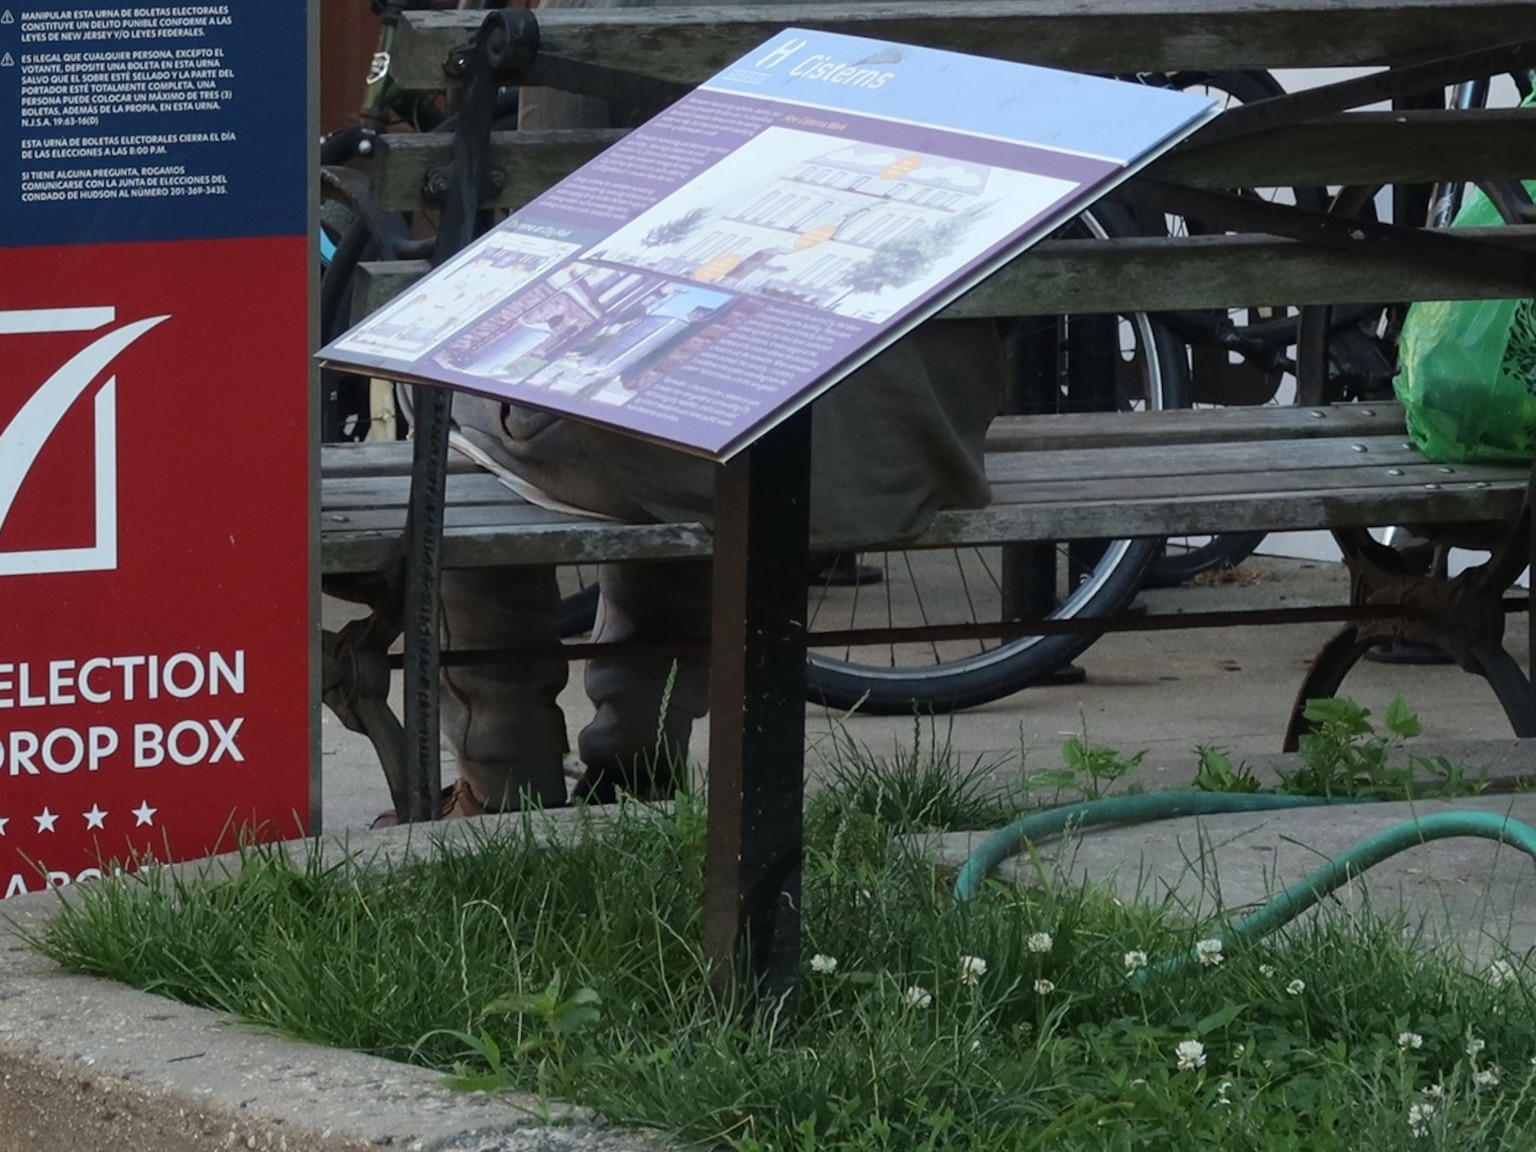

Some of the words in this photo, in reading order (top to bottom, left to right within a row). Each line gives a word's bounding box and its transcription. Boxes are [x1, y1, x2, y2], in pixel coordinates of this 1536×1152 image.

[789, 54, 895, 90] Cisterns
[21, 139, 42, 149] ESTA
[43, 138, 68, 148] URNA
[69, 138, 80, 147] DE
[82, 137, 120, 146] BOLETAS
[120, 134, 178, 145] ELECTORALES
[179, 133, 209, 143] CIERRA
[210, 133, 219, 142] EL
[221, 130, 236, 141] DÍA
[21, 150, 33, 159] DE
[34, 150, 50, 159] LAS
[52, 148, 103, 158] ELECCIONES
[112, 147, 128, 156] LAS
[22, 172, 30, 181] SI
[31, 171, 55, 180] TIENE
[56, 169, 92, 179] ALGUNA
[141, 166, 185, 176] ROGAMOS
[21, 180, 84, 191] COMUNICARSE
[85, 180, 105, 189] CON
[106, 179, 117, 188] LA
[119, 178, 146, 188] JUNTA
[146, 178, 158, 186] DE
[159, 176, 210, 186] ELECCIONES
[211, 175, 226, 184] DEL
[21, 192, 66, 202] CONDADO
[67, 191, 78, 200] DE
[80, 190, 118, 200] HUDSON
[119, 189, 129, 198] AL
[131, 185, 169, 198] NÚMERO
[135, 718, 244, 767] BOX
